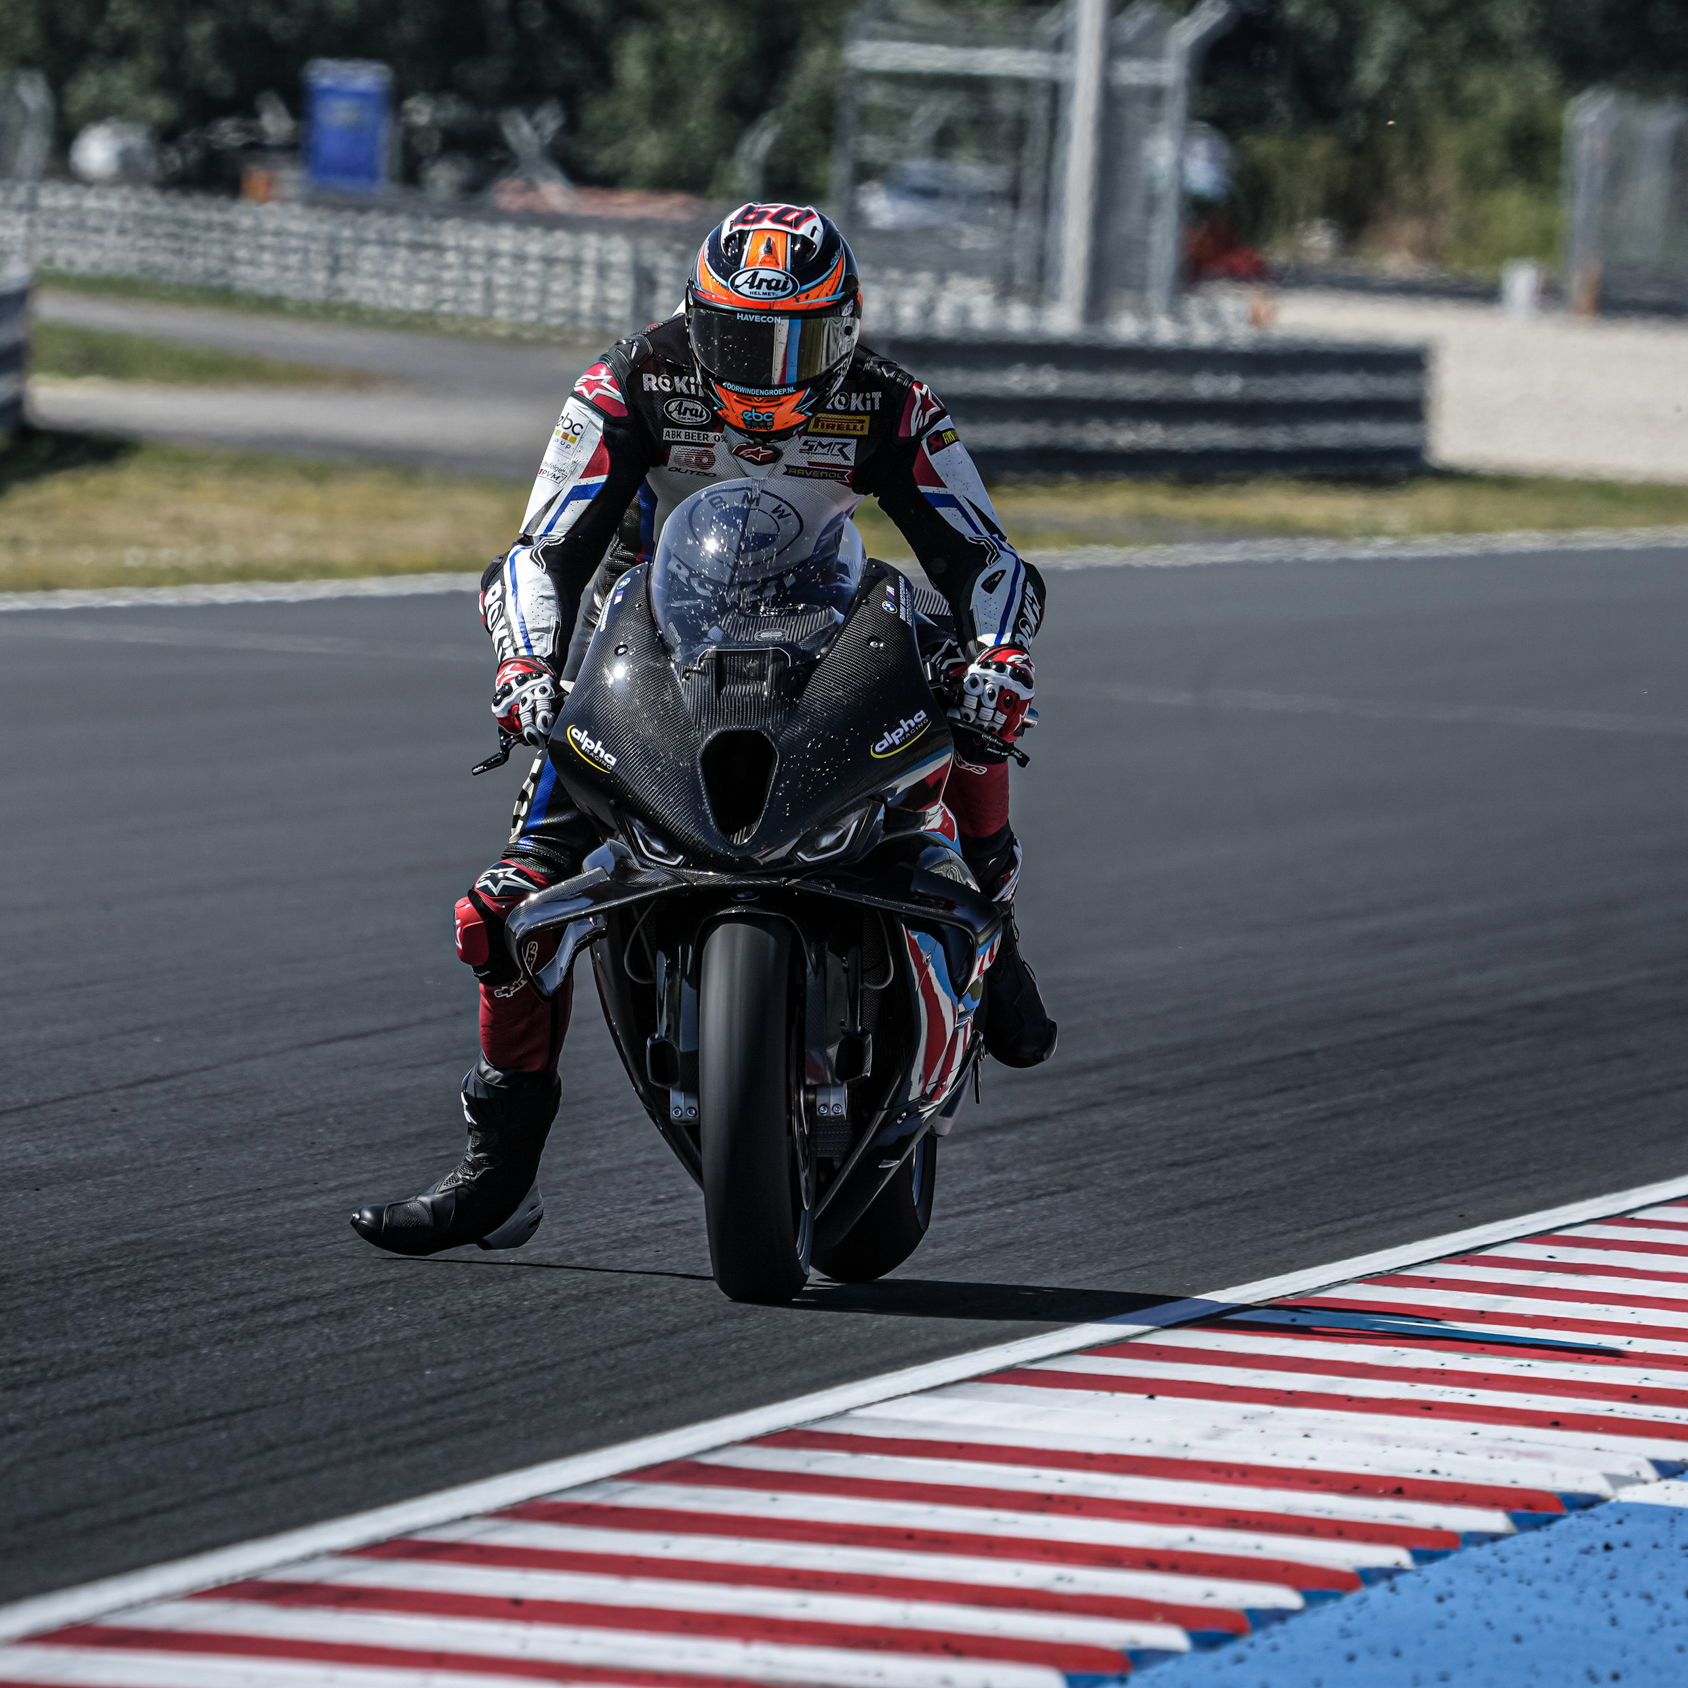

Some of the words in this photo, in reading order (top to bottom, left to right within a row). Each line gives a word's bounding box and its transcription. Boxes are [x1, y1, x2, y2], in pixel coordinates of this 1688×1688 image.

[732, 205, 818, 231] 60
[733, 271, 793, 292] Arai
[736, 312, 781, 323] HAVECON
[668, 401, 706, 418] Arai
[826, 391, 882, 411] OKiT
[742, 408, 774, 422] ebc
[814, 417, 865, 432] PIRELLI
[684, 431, 709, 442] BEER
[799, 440, 852, 461] SMR
[668, 466, 717, 477] OUTDO
[788, 467, 842, 479] RAVENOL
[875, 710, 927, 752] alpha
[900, 718, 929, 742] RACING
[571, 728, 617, 766] alpha
[584, 748, 613, 770] RACING
